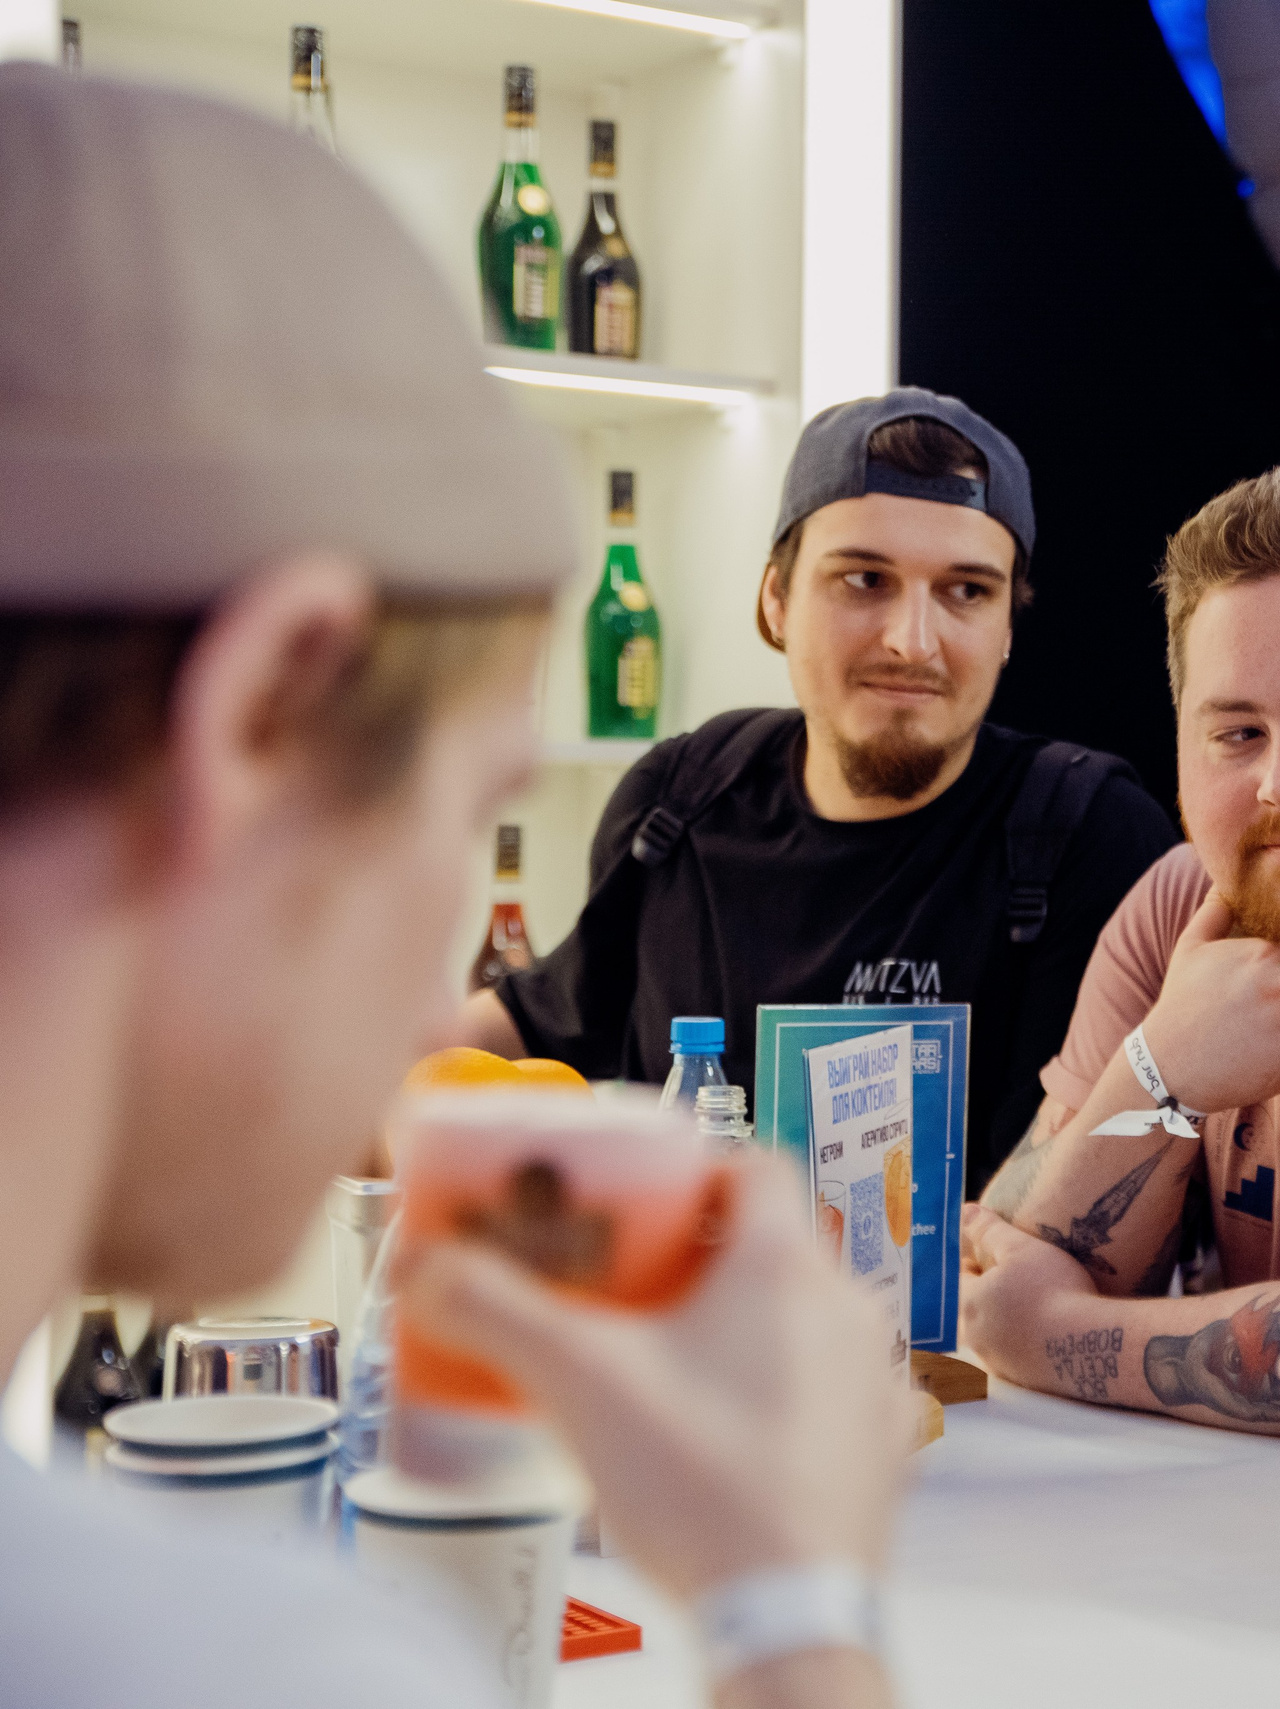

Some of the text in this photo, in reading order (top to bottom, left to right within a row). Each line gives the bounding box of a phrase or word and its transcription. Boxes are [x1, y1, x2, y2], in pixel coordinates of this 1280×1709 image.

[827, 1043, 898, 1089] ВЫИГРАЙ НАБОР
[832, 1092, 850, 1124] ДЛЯ
